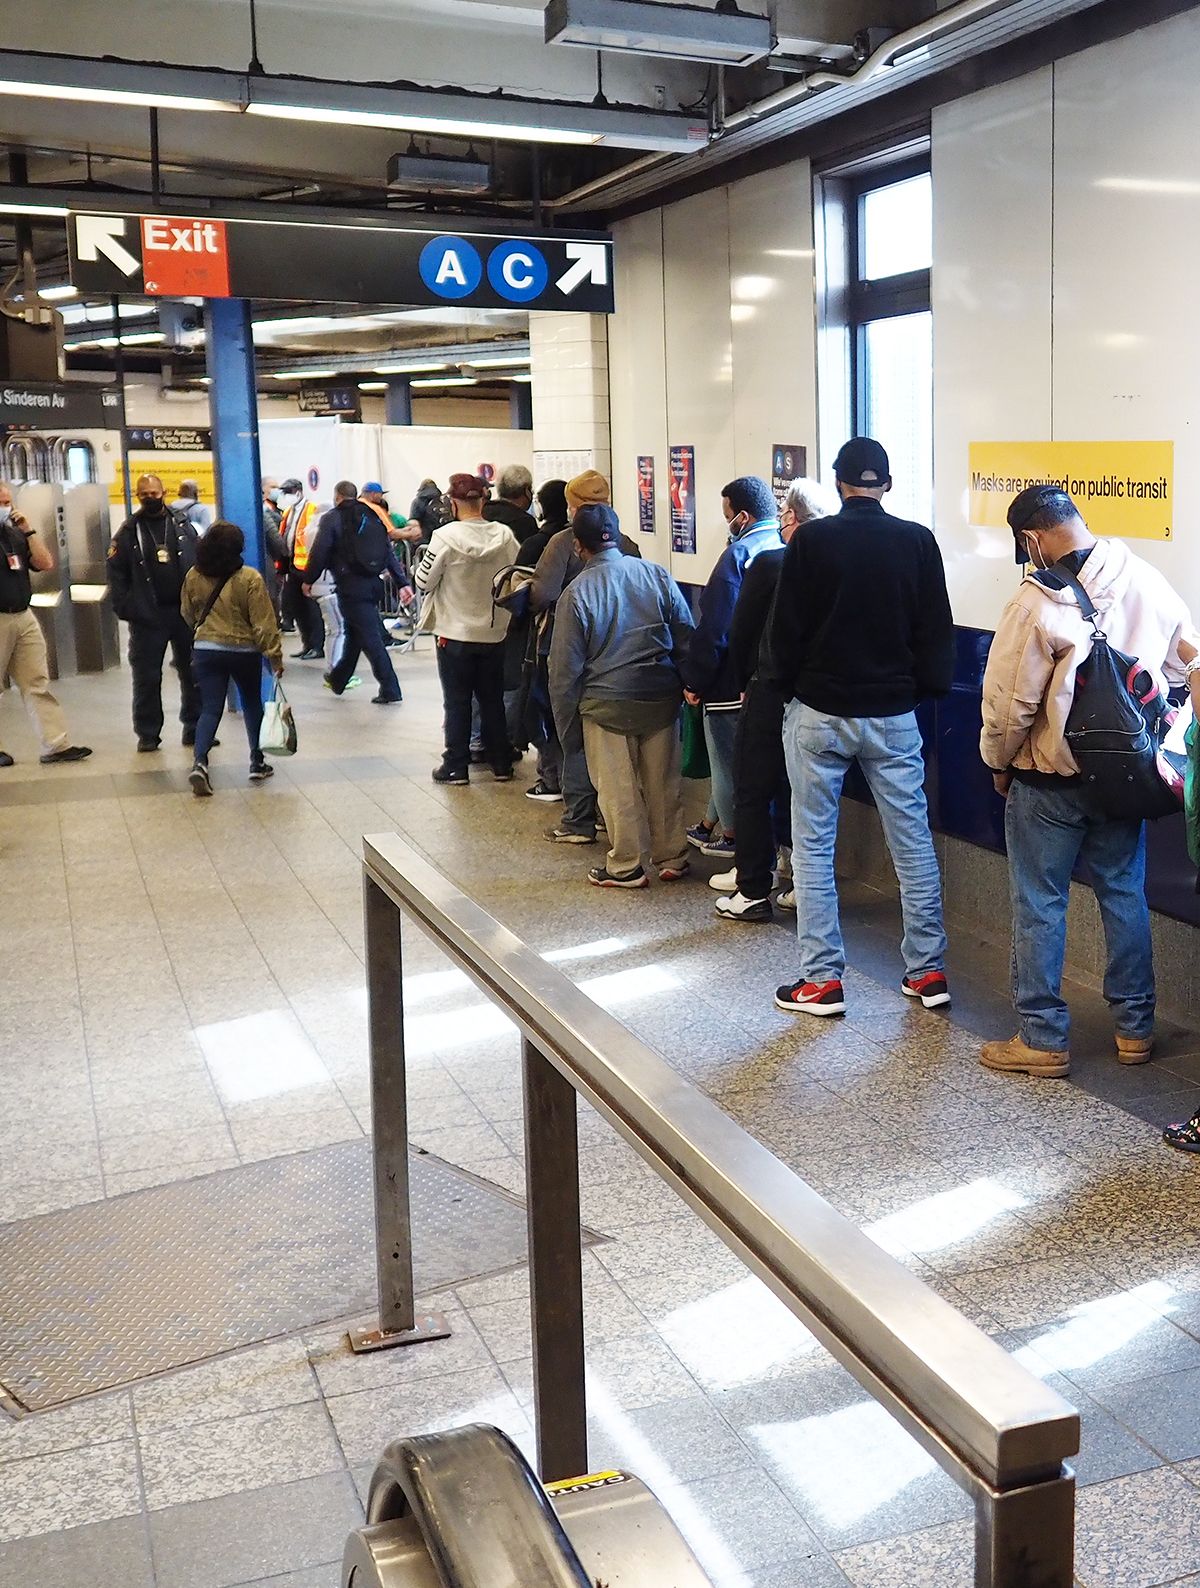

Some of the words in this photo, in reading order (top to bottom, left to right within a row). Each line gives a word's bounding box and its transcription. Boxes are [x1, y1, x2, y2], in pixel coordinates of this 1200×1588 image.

[143, 218, 218, 253] Exit
[435, 249, 466, 285] A
[502, 252, 534, 289] C
[3, 389, 50, 407] Sinderen
[52, 393, 65, 408] Av
[775, 455, 783, 469] A
[785, 456, 791, 470] S
[972, 472, 1004, 492] Masks
[1005, 479, 1022, 492] are
[1072, 482, 1086, 496] on
[1088, 475, 1124, 500] public
[1127, 476, 1168, 499] transit
[547, 1475, 625, 1497] CAUTI
